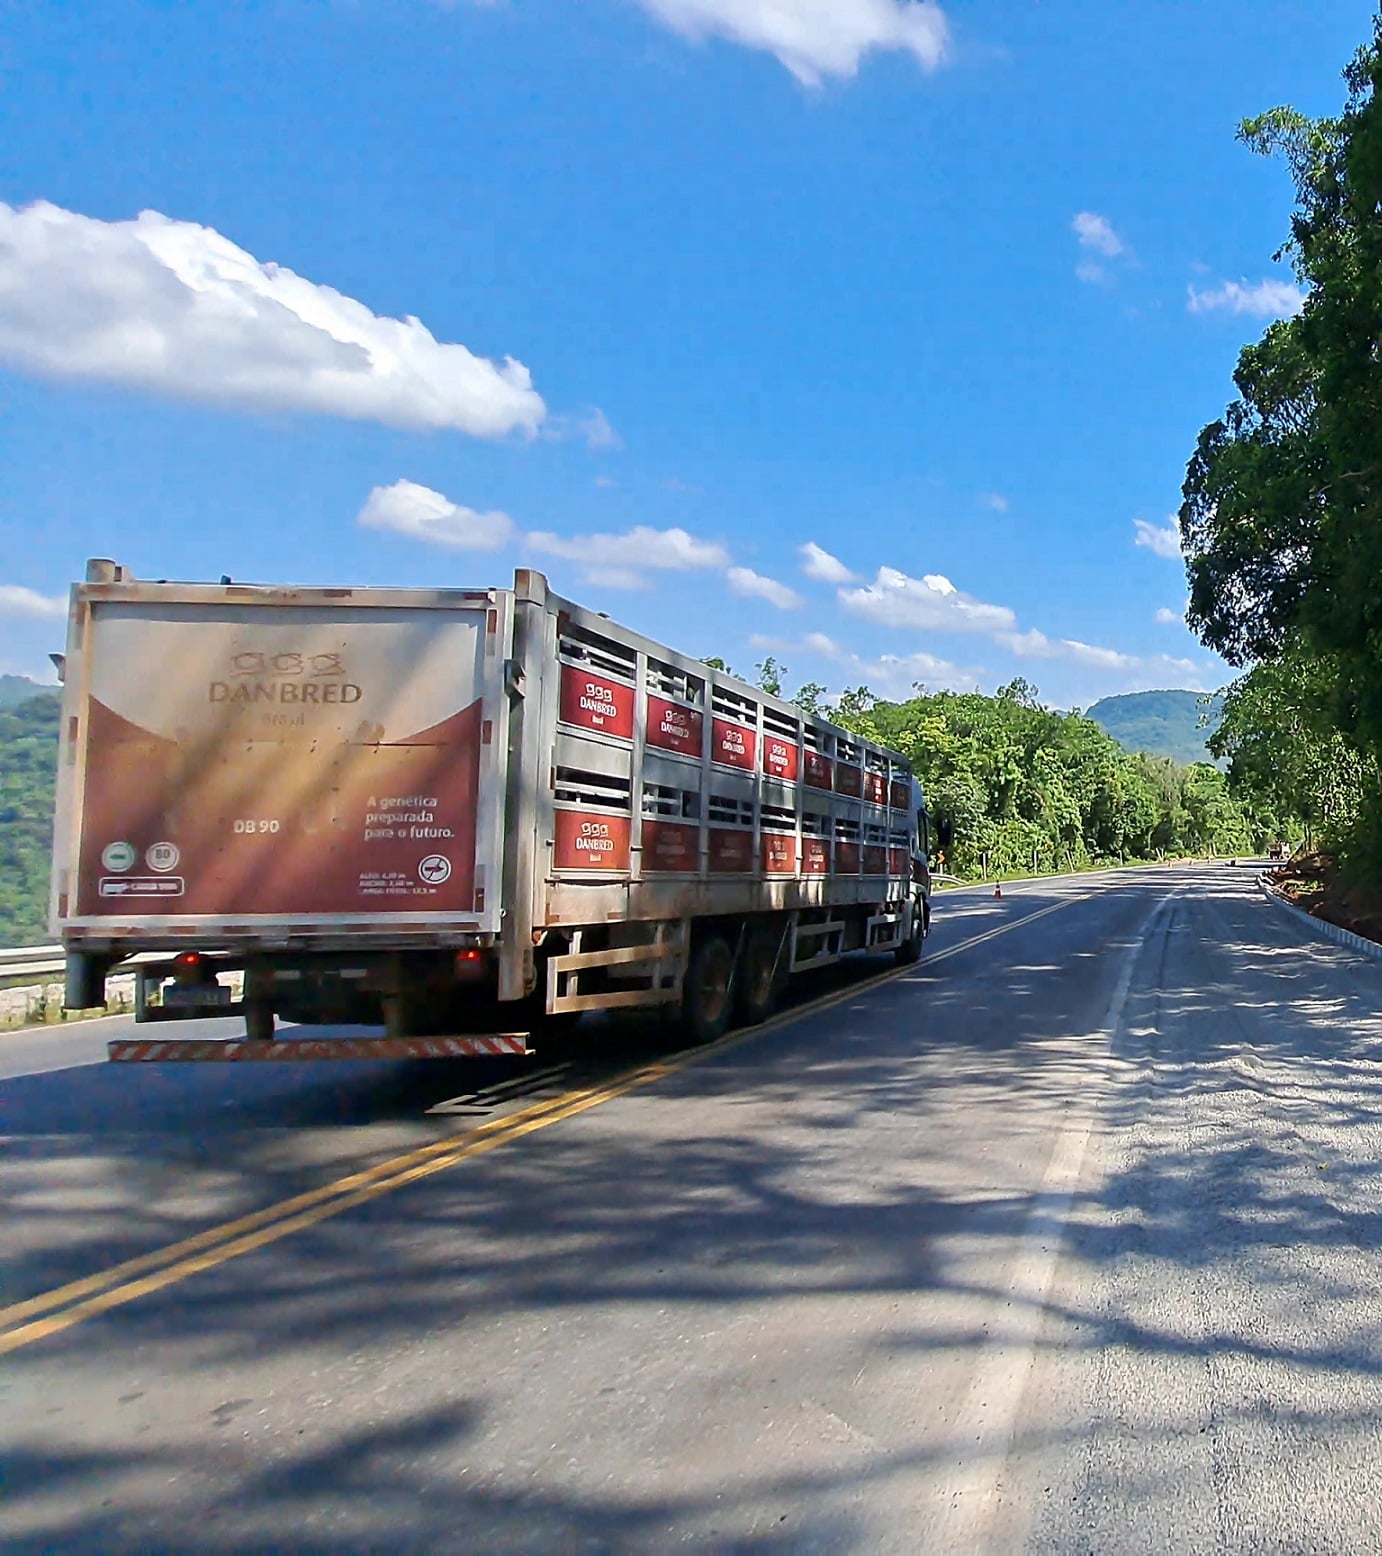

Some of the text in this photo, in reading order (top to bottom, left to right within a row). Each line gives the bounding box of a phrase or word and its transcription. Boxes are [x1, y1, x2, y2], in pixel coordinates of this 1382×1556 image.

[209, 682, 363, 704] DANBRED
[579, 696, 617, 717] DANBRED
[366, 796, 377, 807] A
[365, 810, 434, 825] preparada
[233, 819, 280, 833] DB 90
[364, 825, 455, 841] para o futuro.
[575, 837, 614, 851] DANBRED
